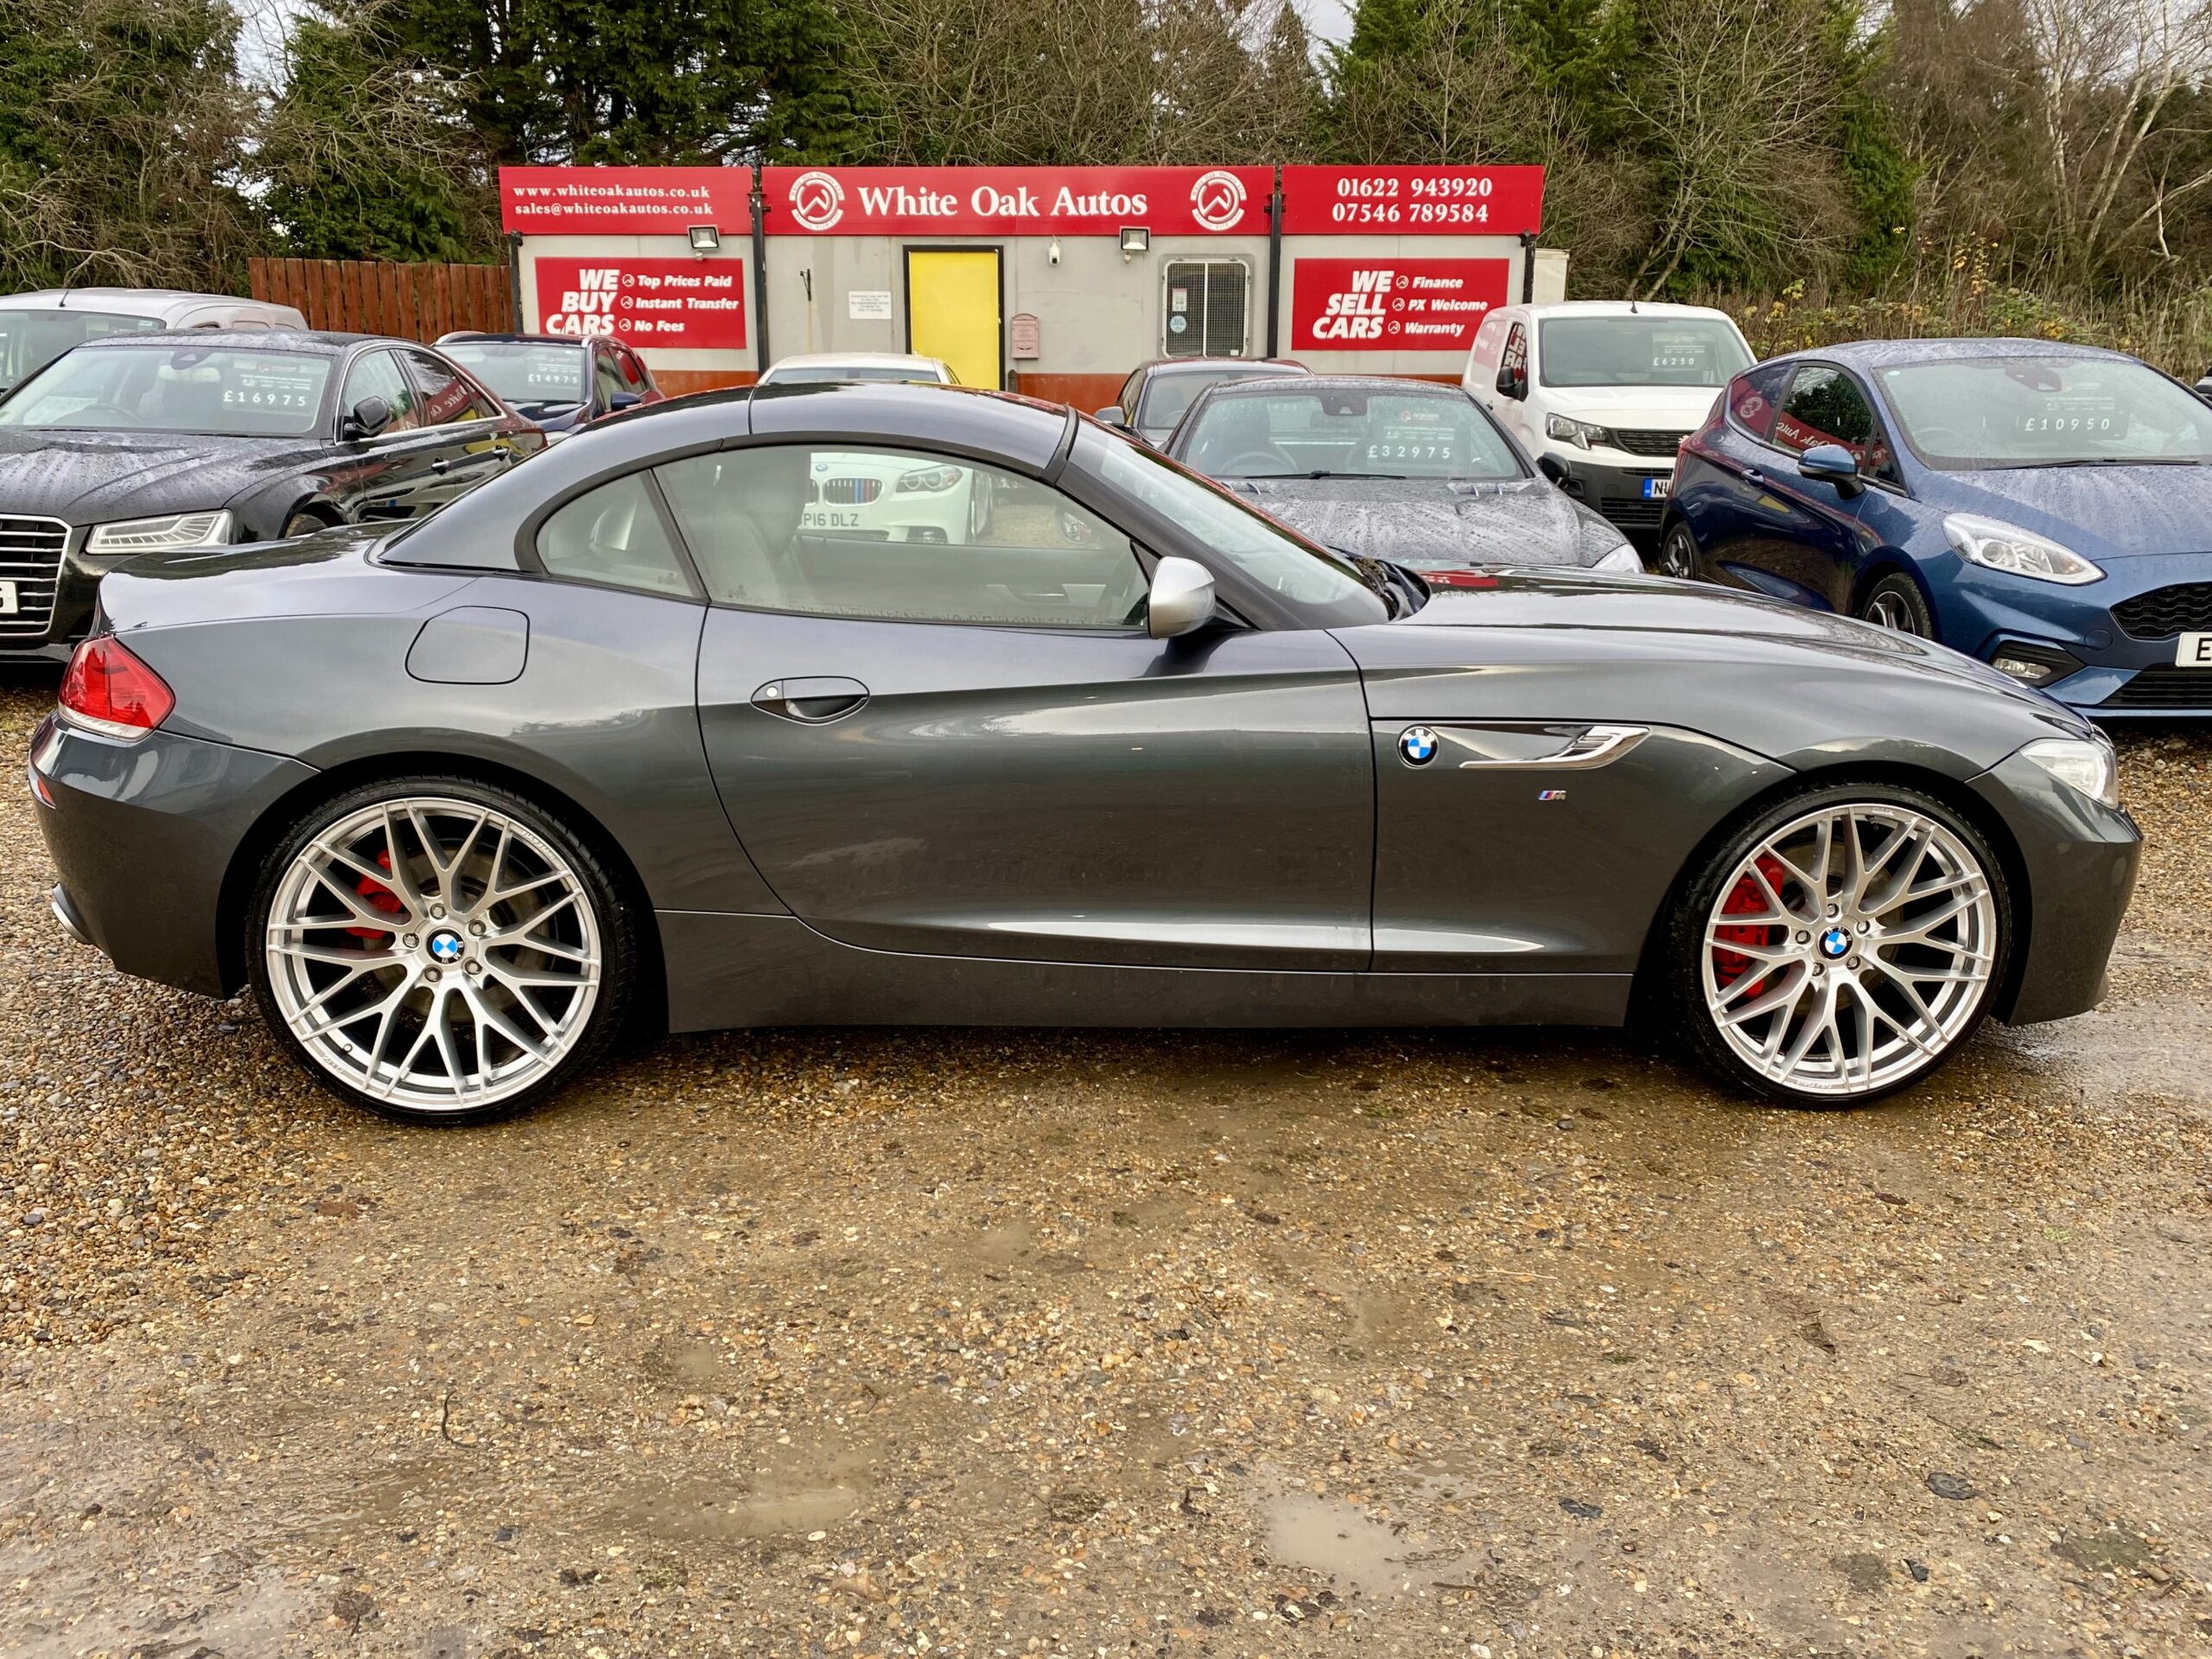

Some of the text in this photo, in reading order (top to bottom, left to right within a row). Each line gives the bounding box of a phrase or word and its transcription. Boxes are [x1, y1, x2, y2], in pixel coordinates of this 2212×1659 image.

[512, 184, 710, 198] www.whiteoakautos.co.uk
[1337, 177, 1493, 197] 01622 943920
[515, 202, 713, 216] sales@whiteoakautos.co.uk
[857, 186, 1148, 217] White Oak Autos
[1332, 202, 1489, 223] 07546 789584
[579, 269, 620, 290] WE
[637, 276, 733, 289] Top Prices Paid
[1351, 270, 1395, 293] WE
[1412, 276, 1464, 289] Finance
[561, 291, 619, 313] BUY
[635, 297, 739, 309] Instant Transfer
[1325, 293, 1387, 316] SELL
[1408, 299, 1489, 311] PX Welcome
[545, 314, 614, 335] CARS
[634, 320, 685, 332] No Fees
[1312, 316, 1385, 340] CARS
[1405, 322, 1465, 338] Warranty
[223, 390, 306, 407] £16975
[2024, 417, 2110, 431] £10950
[1368, 444, 1451, 459] £32975
[830, 513, 859, 526] DLZ
